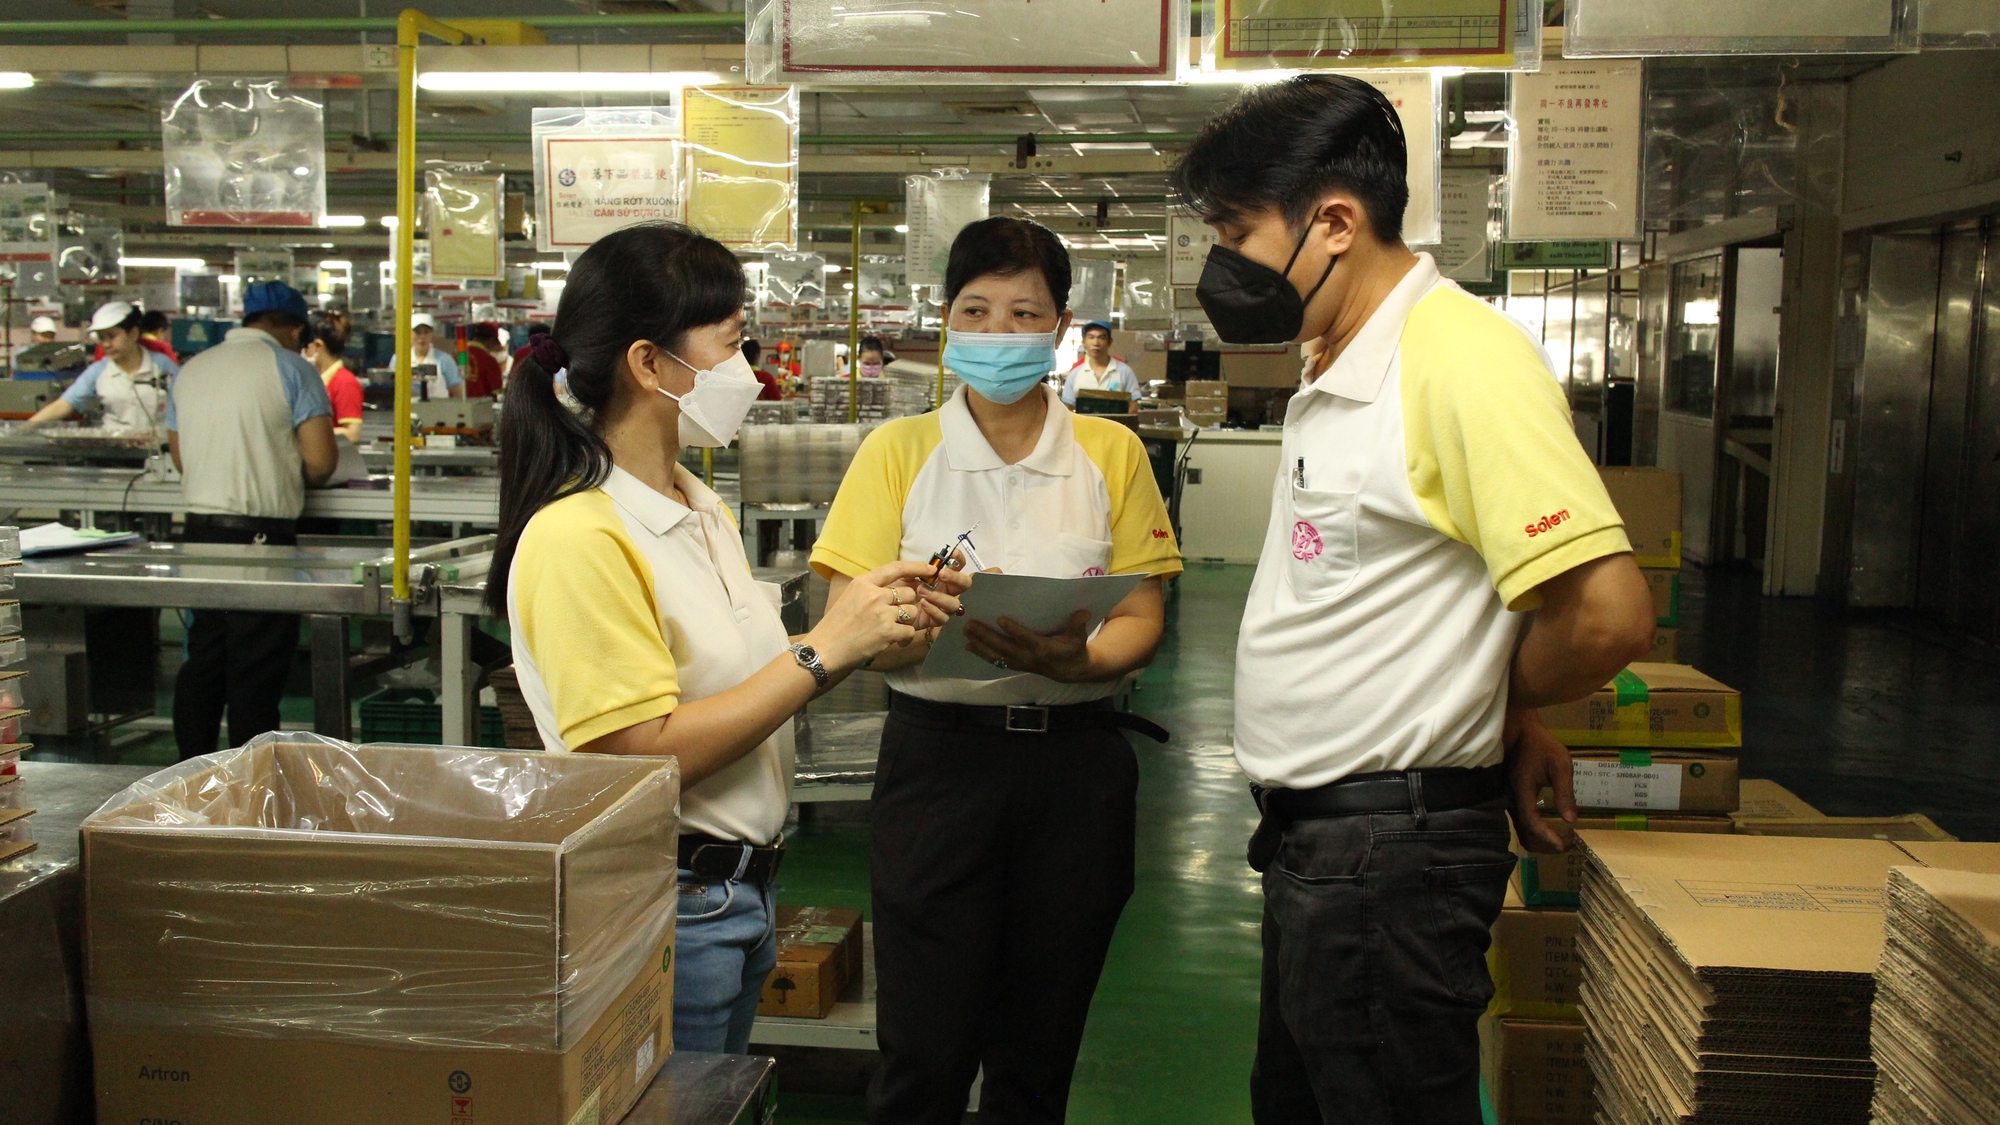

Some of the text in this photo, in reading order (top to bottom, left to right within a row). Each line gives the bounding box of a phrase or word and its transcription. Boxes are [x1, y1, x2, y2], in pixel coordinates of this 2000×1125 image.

[1525, 508, 1571, 538] Solen
[1545, 952, 1568, 962] ITEM
[1546, 1056, 1570, 1068] ITEM
[138, 1065, 190, 1082] Artron
